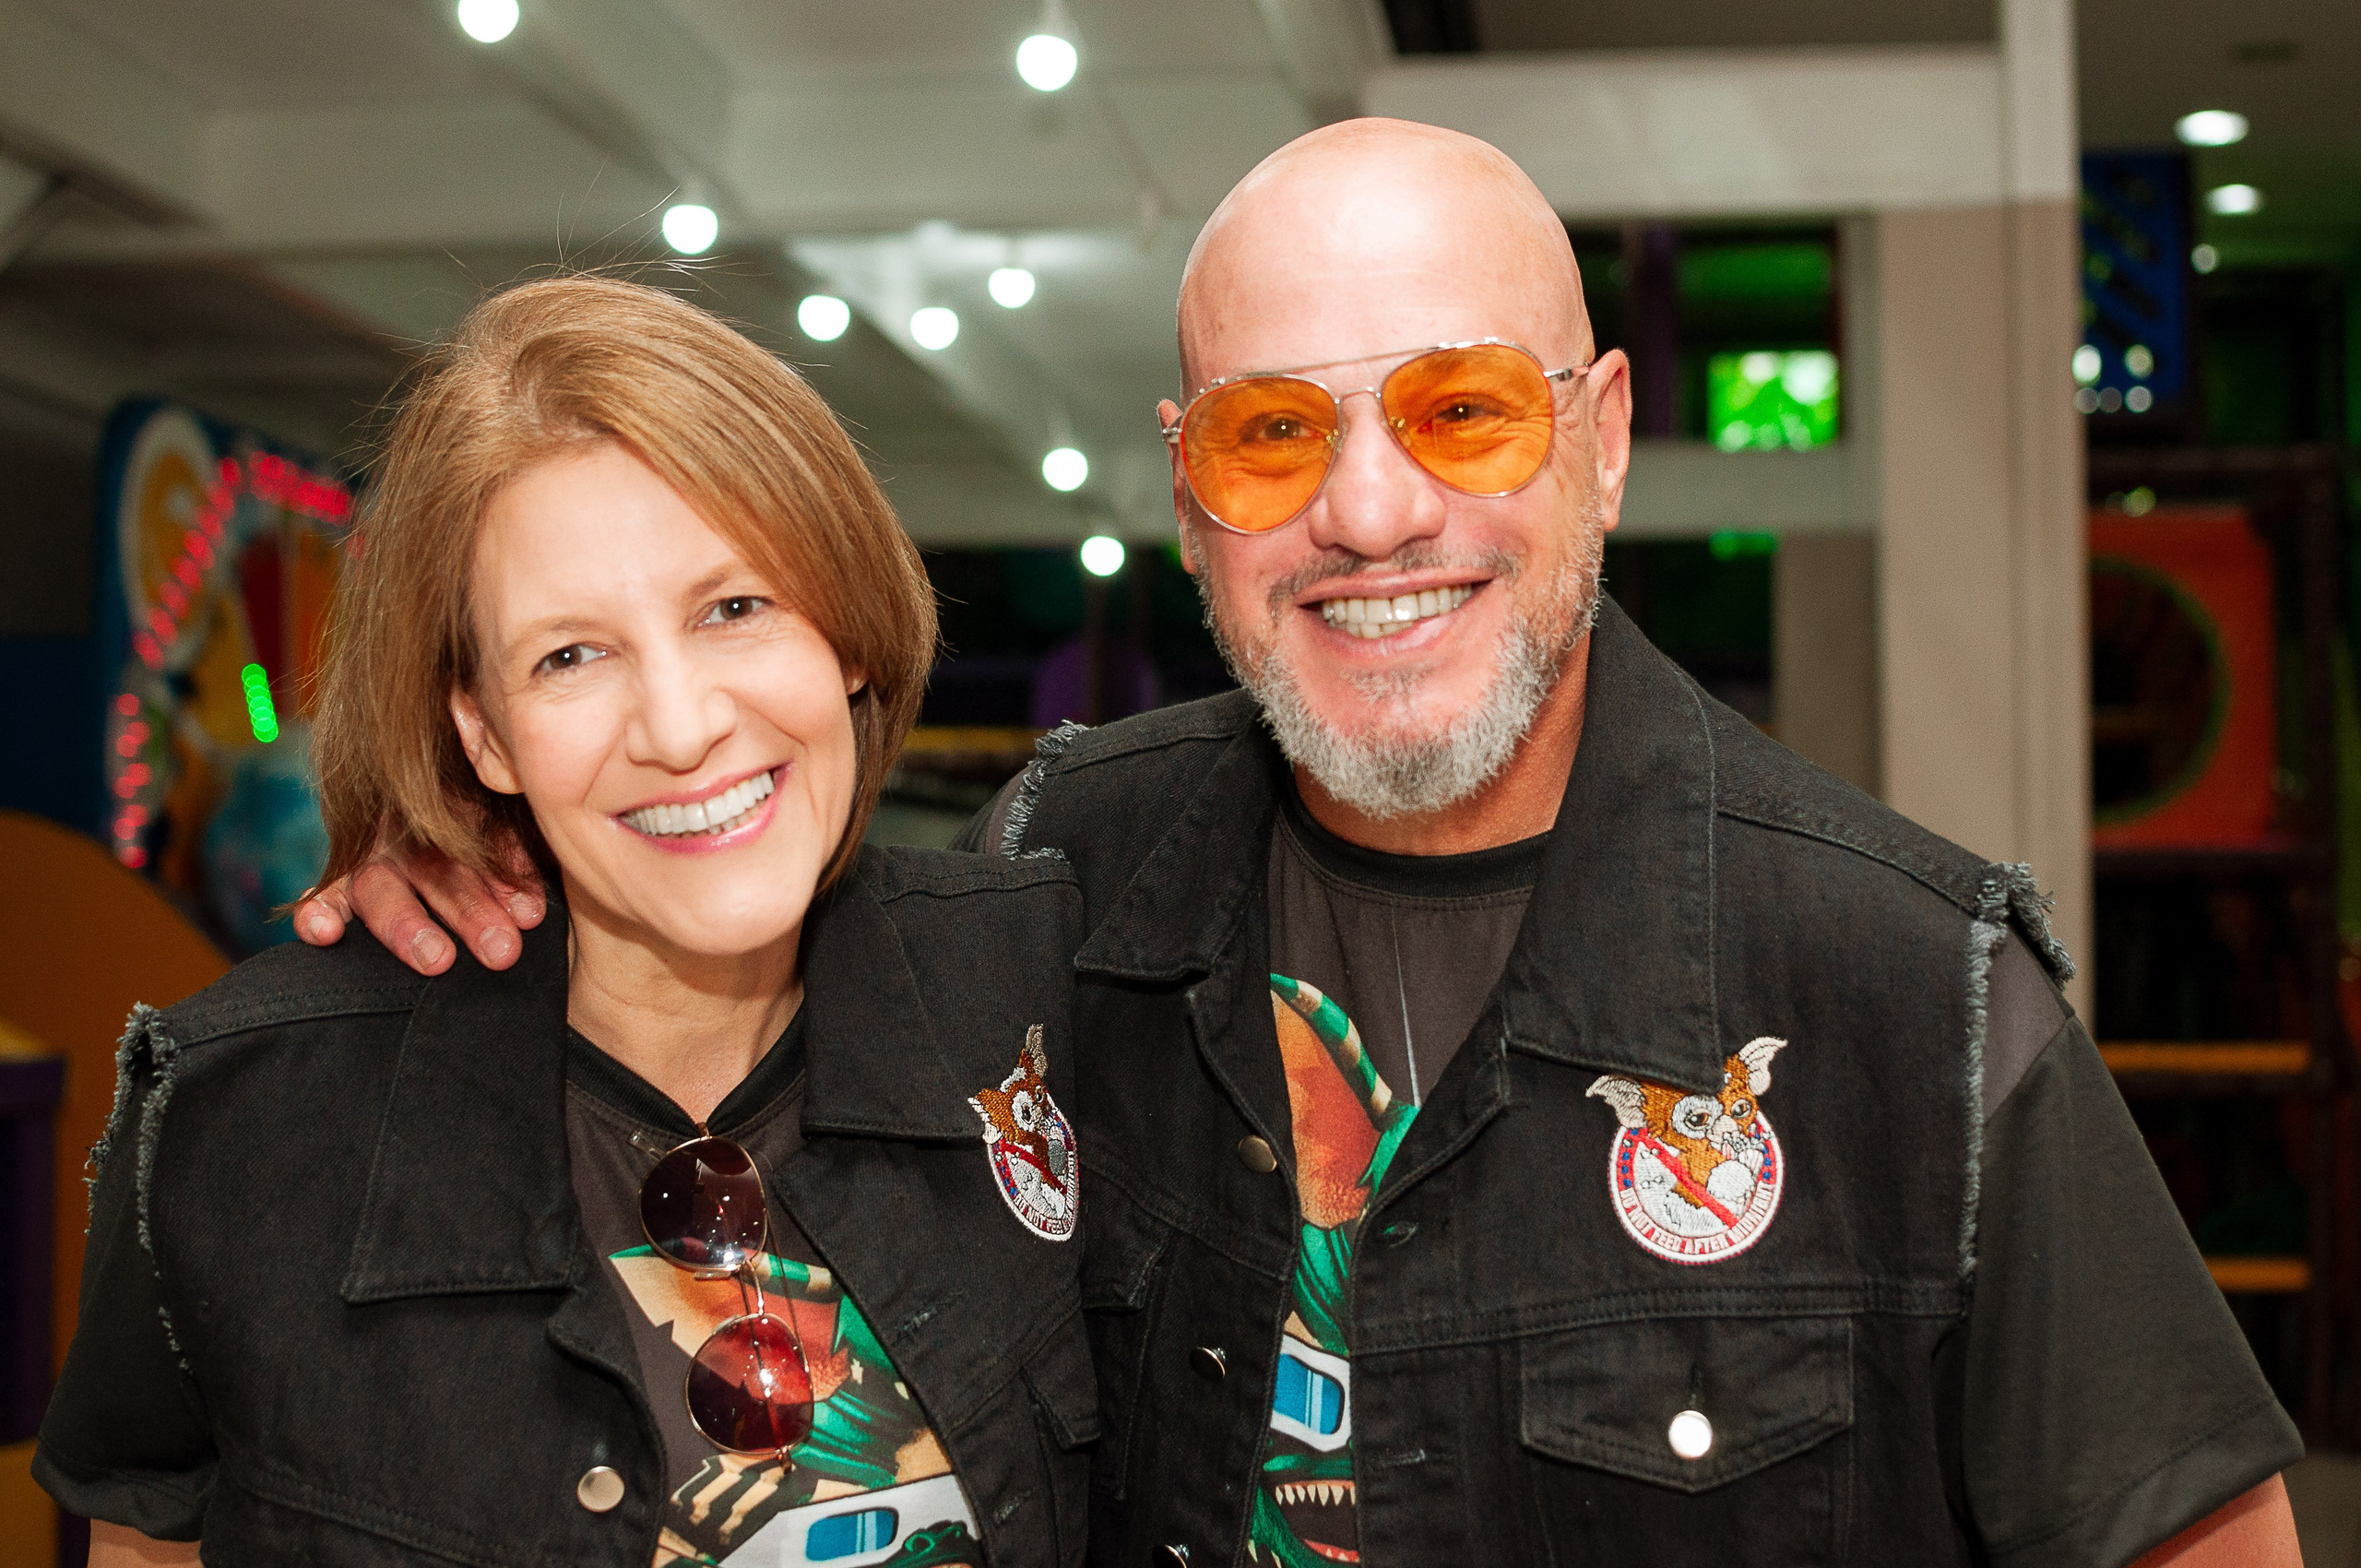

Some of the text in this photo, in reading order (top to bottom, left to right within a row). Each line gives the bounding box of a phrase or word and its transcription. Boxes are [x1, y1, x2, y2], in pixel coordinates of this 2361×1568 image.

[1026, 1207, 1045, 1230] NOT
[1619, 1181, 1775, 1254] DO NOT FEED AFTER MIDNIGHT
